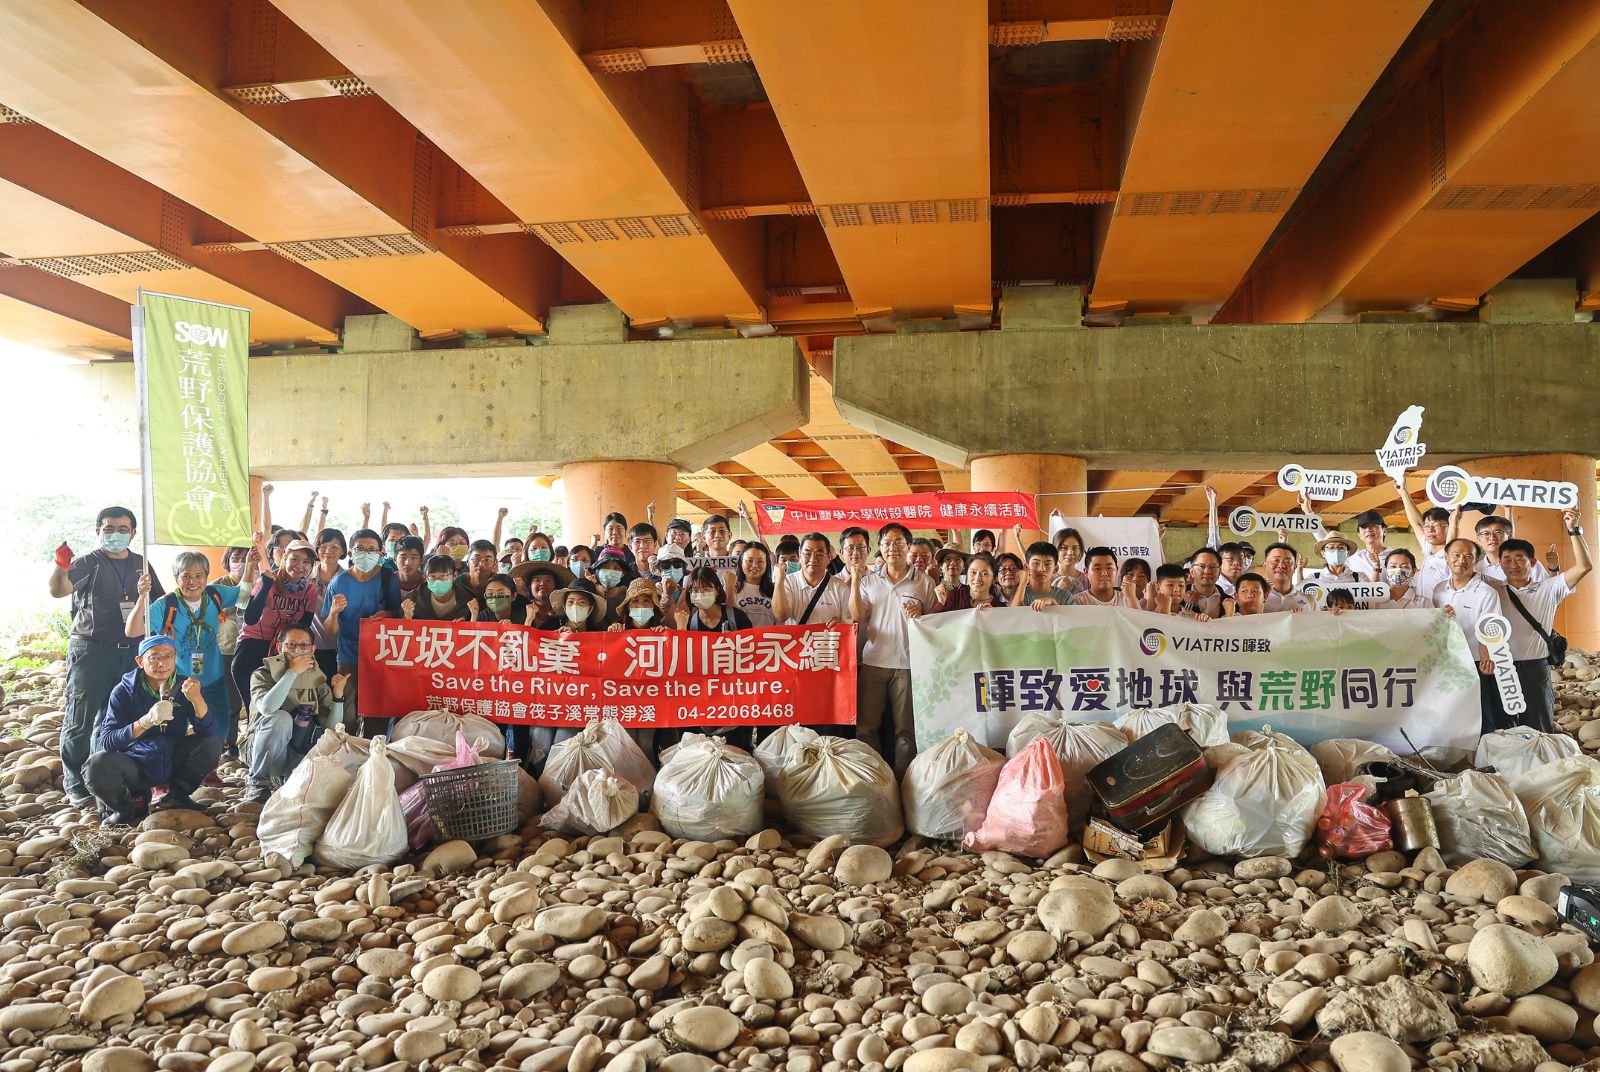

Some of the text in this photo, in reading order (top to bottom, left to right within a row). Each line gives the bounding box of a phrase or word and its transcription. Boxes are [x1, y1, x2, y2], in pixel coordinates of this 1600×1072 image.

[178, 349, 218, 512] 荒野保護協會
[1379, 445, 1423, 460] VIATRIS
[1385, 457, 1416, 468] TAIWAN
[1305, 473, 1352, 485] VIATRIS
[1304, 486, 1339, 496] TAIWAN
[1475, 481, 1572, 505] VIATRIS
[790, 503, 1028, 521] 中山醫學大學附設醫院 健康永續活動
[1260, 516, 1319, 530] VIATRIS
[689, 558, 738, 569] VIATRIS
[738, 596, 772, 610] CSMU
[1493, 645, 1522, 711] VIATRIS
[431, 672, 790, 700] Save the River, Save the Future.
[677, 703, 794, 720] 04-22068468
